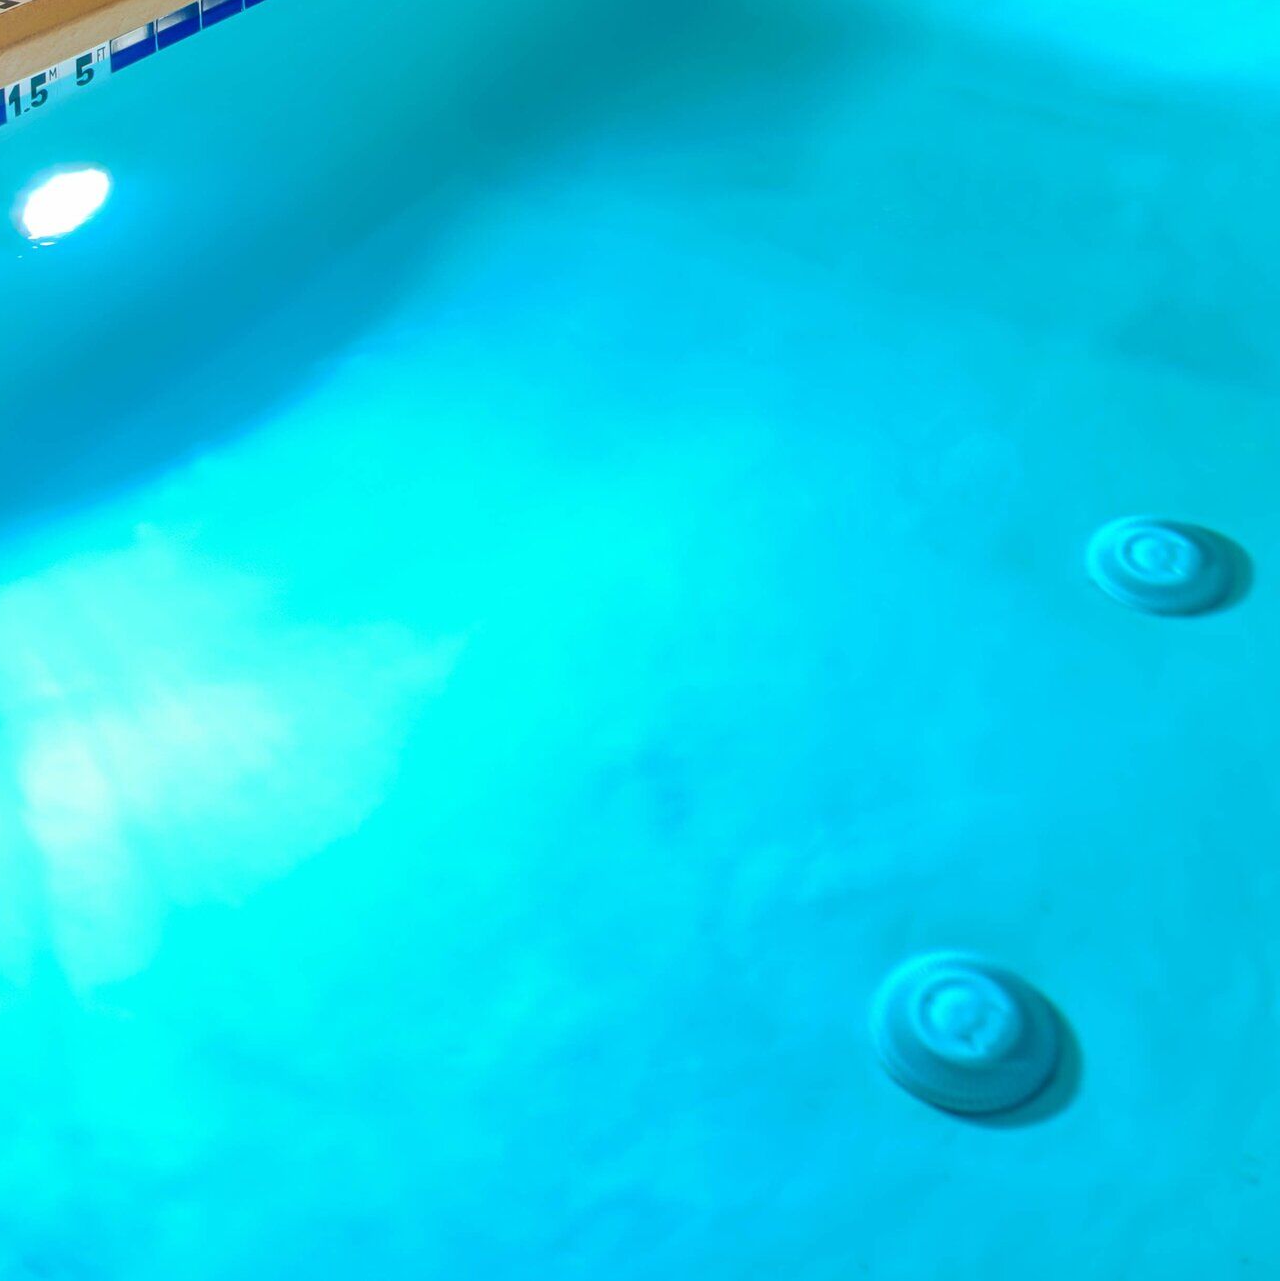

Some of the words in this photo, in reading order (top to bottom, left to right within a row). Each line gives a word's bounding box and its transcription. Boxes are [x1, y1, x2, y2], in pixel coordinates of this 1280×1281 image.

[8, 72, 48, 118] 1.5
[48, 66, 58, 81] M
[75, 52, 95, 86] 5
[96, 46, 106, 63] FT
